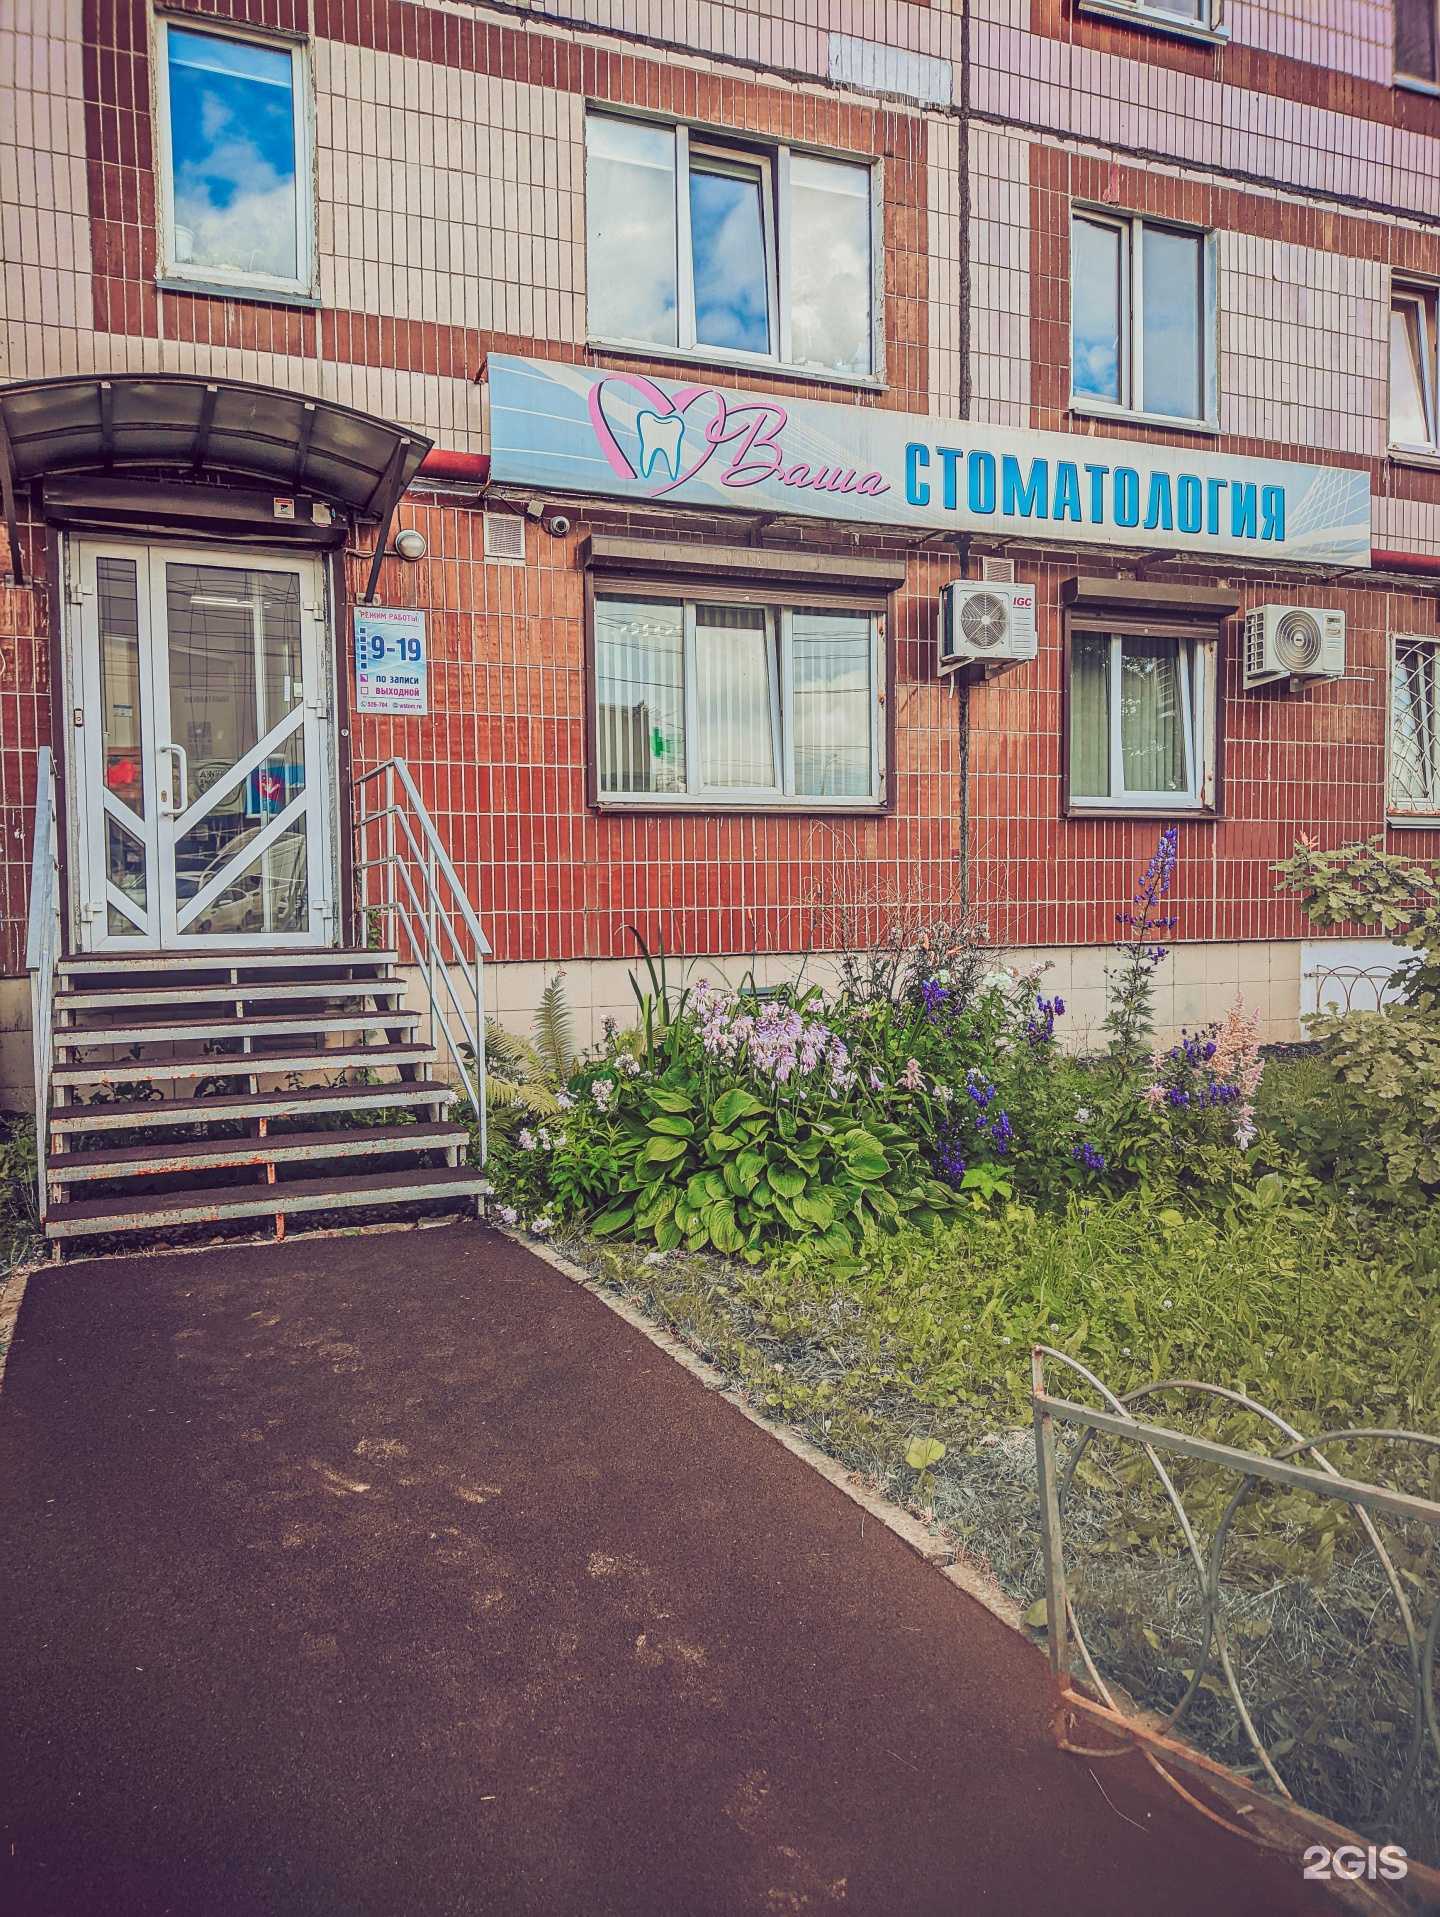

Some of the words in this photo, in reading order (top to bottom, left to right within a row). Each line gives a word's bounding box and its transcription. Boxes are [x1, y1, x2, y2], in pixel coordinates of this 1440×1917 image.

[705, 402, 891, 496] Ваша
[905, 442, 1285, 541] СТОМАТОЛОГИЯ
[1013, 597, 1032, 607] IGC
[360, 611, 387, 620] РЕЖИМ
[389, 613, 418, 622] РАБОТЫ
[371, 635, 422, 662] 9-19
[376, 675, 386, 683] по
[390, 676, 419, 684] записи
[375, 687, 420, 697] ВЫХОДНОЙ
